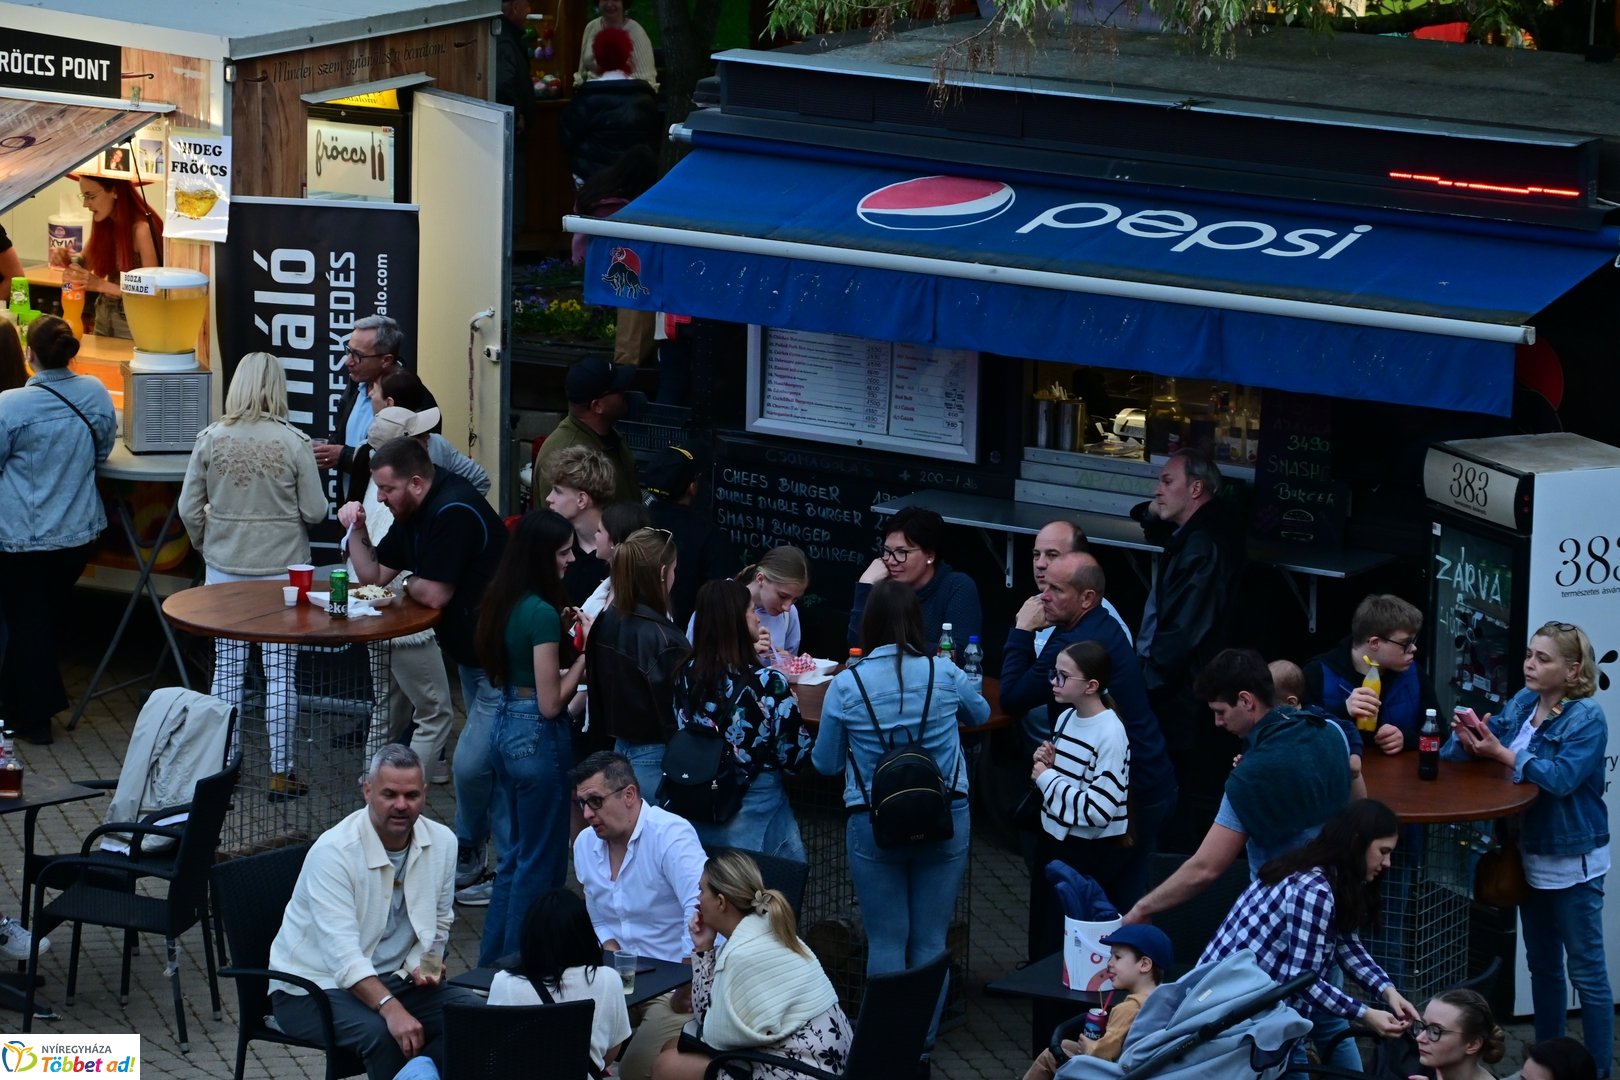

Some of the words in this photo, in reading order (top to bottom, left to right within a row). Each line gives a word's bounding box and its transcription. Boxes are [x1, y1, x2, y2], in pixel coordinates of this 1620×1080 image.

[62, 56, 110, 81] PONT
[171, 160, 228, 177] FRÖCCS
[316, 129, 367, 176] fröccs
[1016, 202, 1373, 260] pepsi
[723, 468, 769, 489] CHEES
[778, 477, 841, 503] BURGER
[1449, 462, 1489, 508] 383
[717, 508, 764, 530] SMASH
[805, 503, 863, 528] BURGER
[1435, 546, 1502, 605] ZÁRVA
